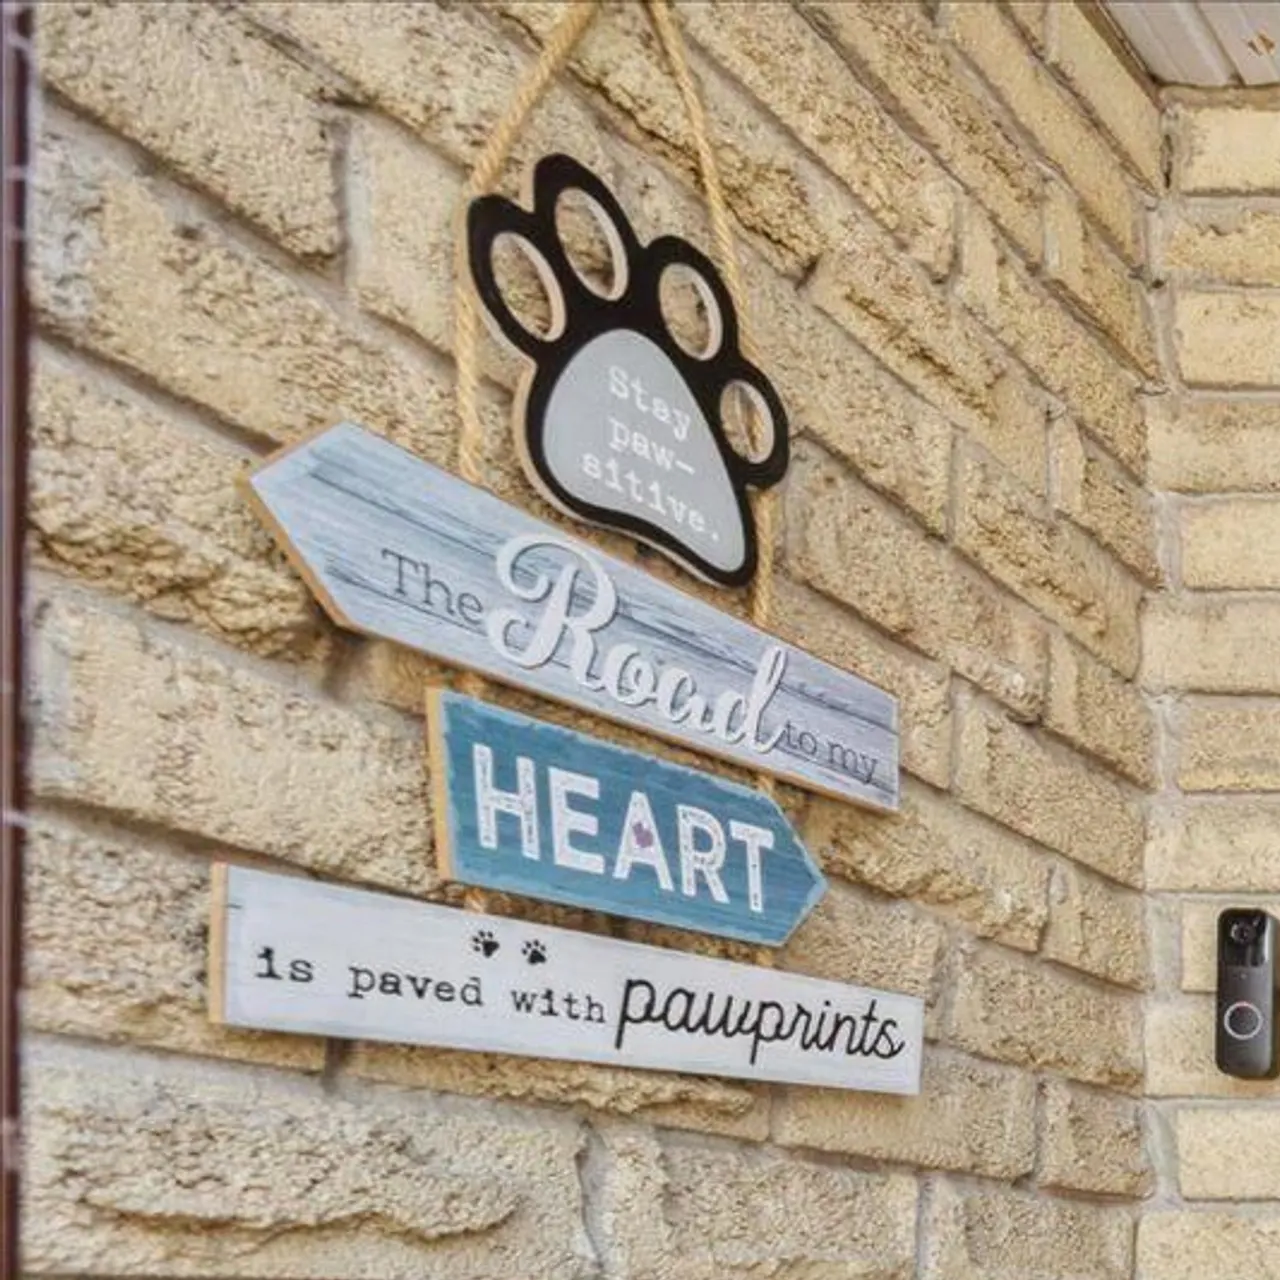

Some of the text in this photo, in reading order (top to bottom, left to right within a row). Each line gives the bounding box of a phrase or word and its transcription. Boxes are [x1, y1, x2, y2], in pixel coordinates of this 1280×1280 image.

[607, 416, 696, 476] paw-
[608, 364, 692, 442] Stay
[581, 452, 720, 542] sitive.
[381, 532, 879, 786] The Road to my
[471, 742, 774, 914] HEART
[255, 946, 905, 1066] is paved with pawprints
